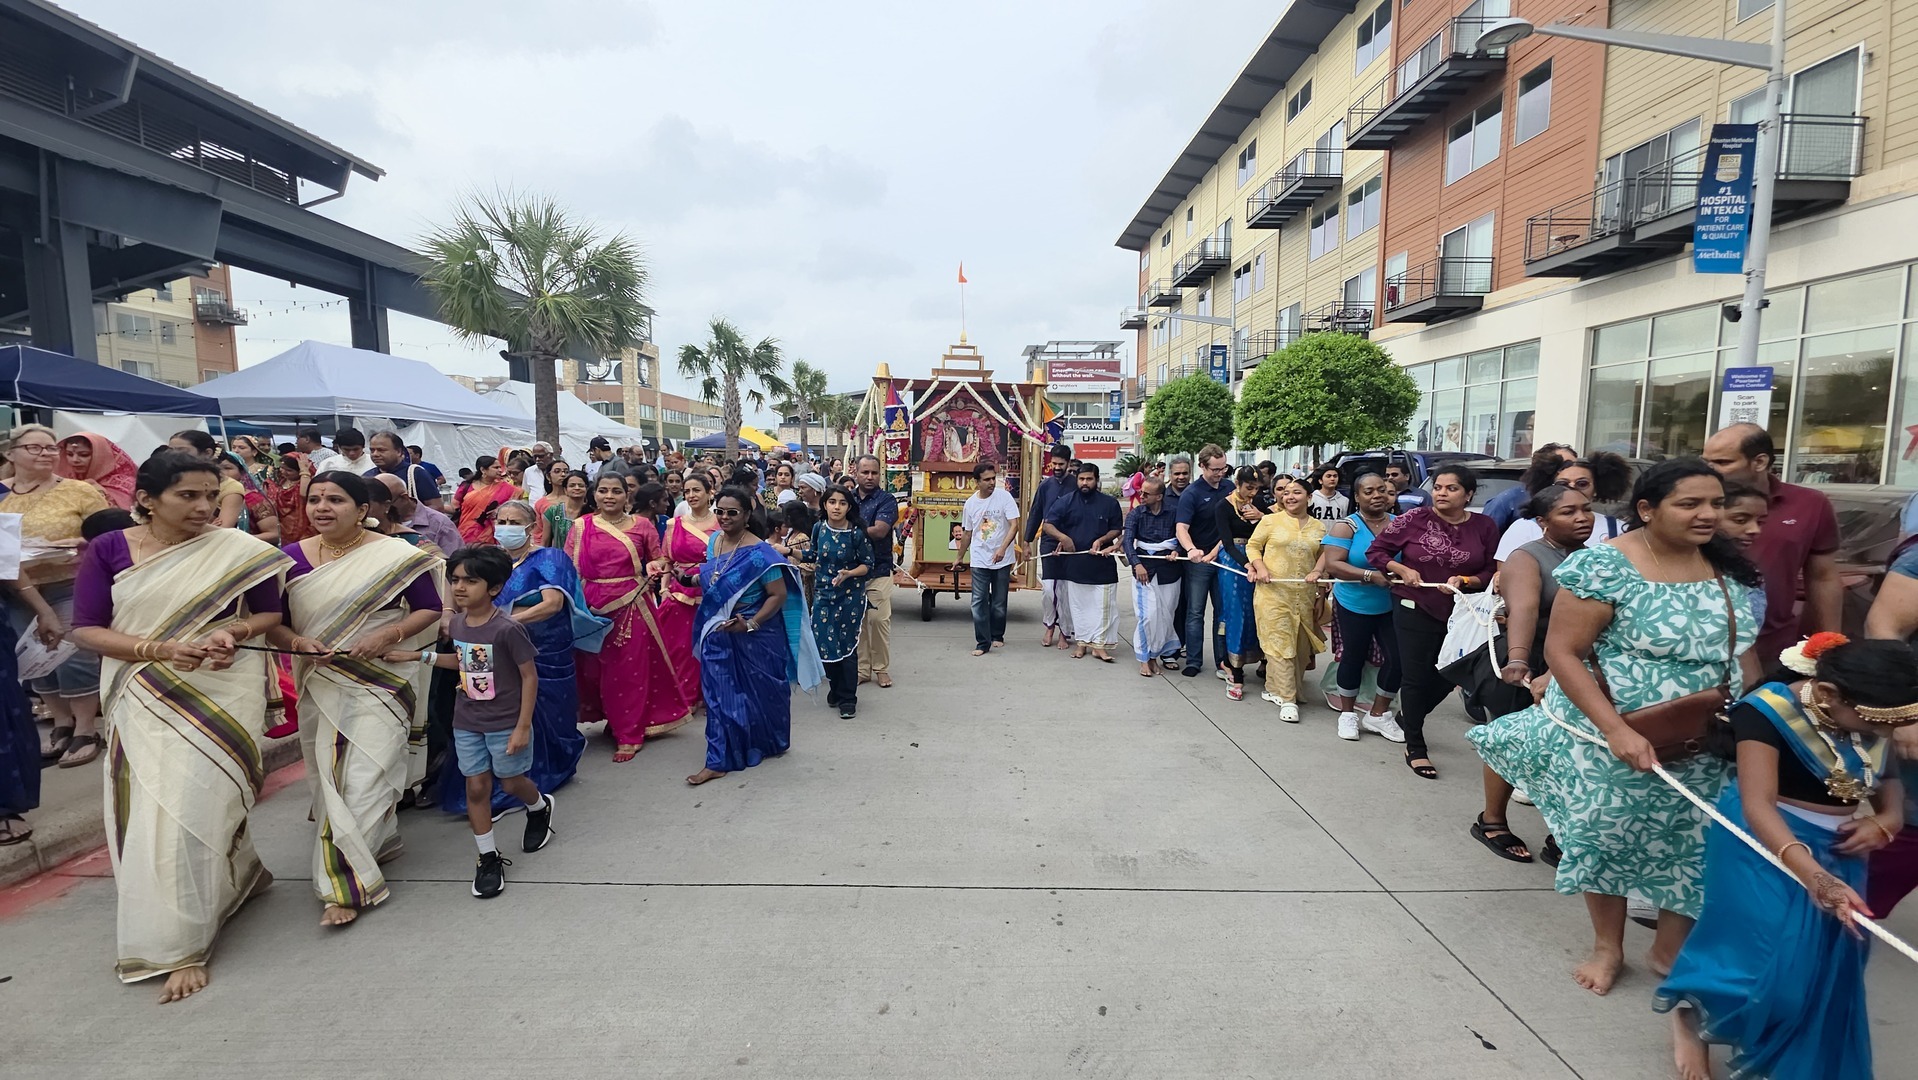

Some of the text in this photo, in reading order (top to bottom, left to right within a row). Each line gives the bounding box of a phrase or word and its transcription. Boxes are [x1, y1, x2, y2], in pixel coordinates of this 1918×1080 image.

[1718, 186, 1732, 195] #1
[1700, 195, 1747, 205] HOSPITAL
[1701, 206, 1745, 215] IN TEXAS
[1697, 224, 1726, 232] PATIENT
[1708, 232, 1739, 240] QUALITY
[1696, 250, 1741, 259] Methodist
